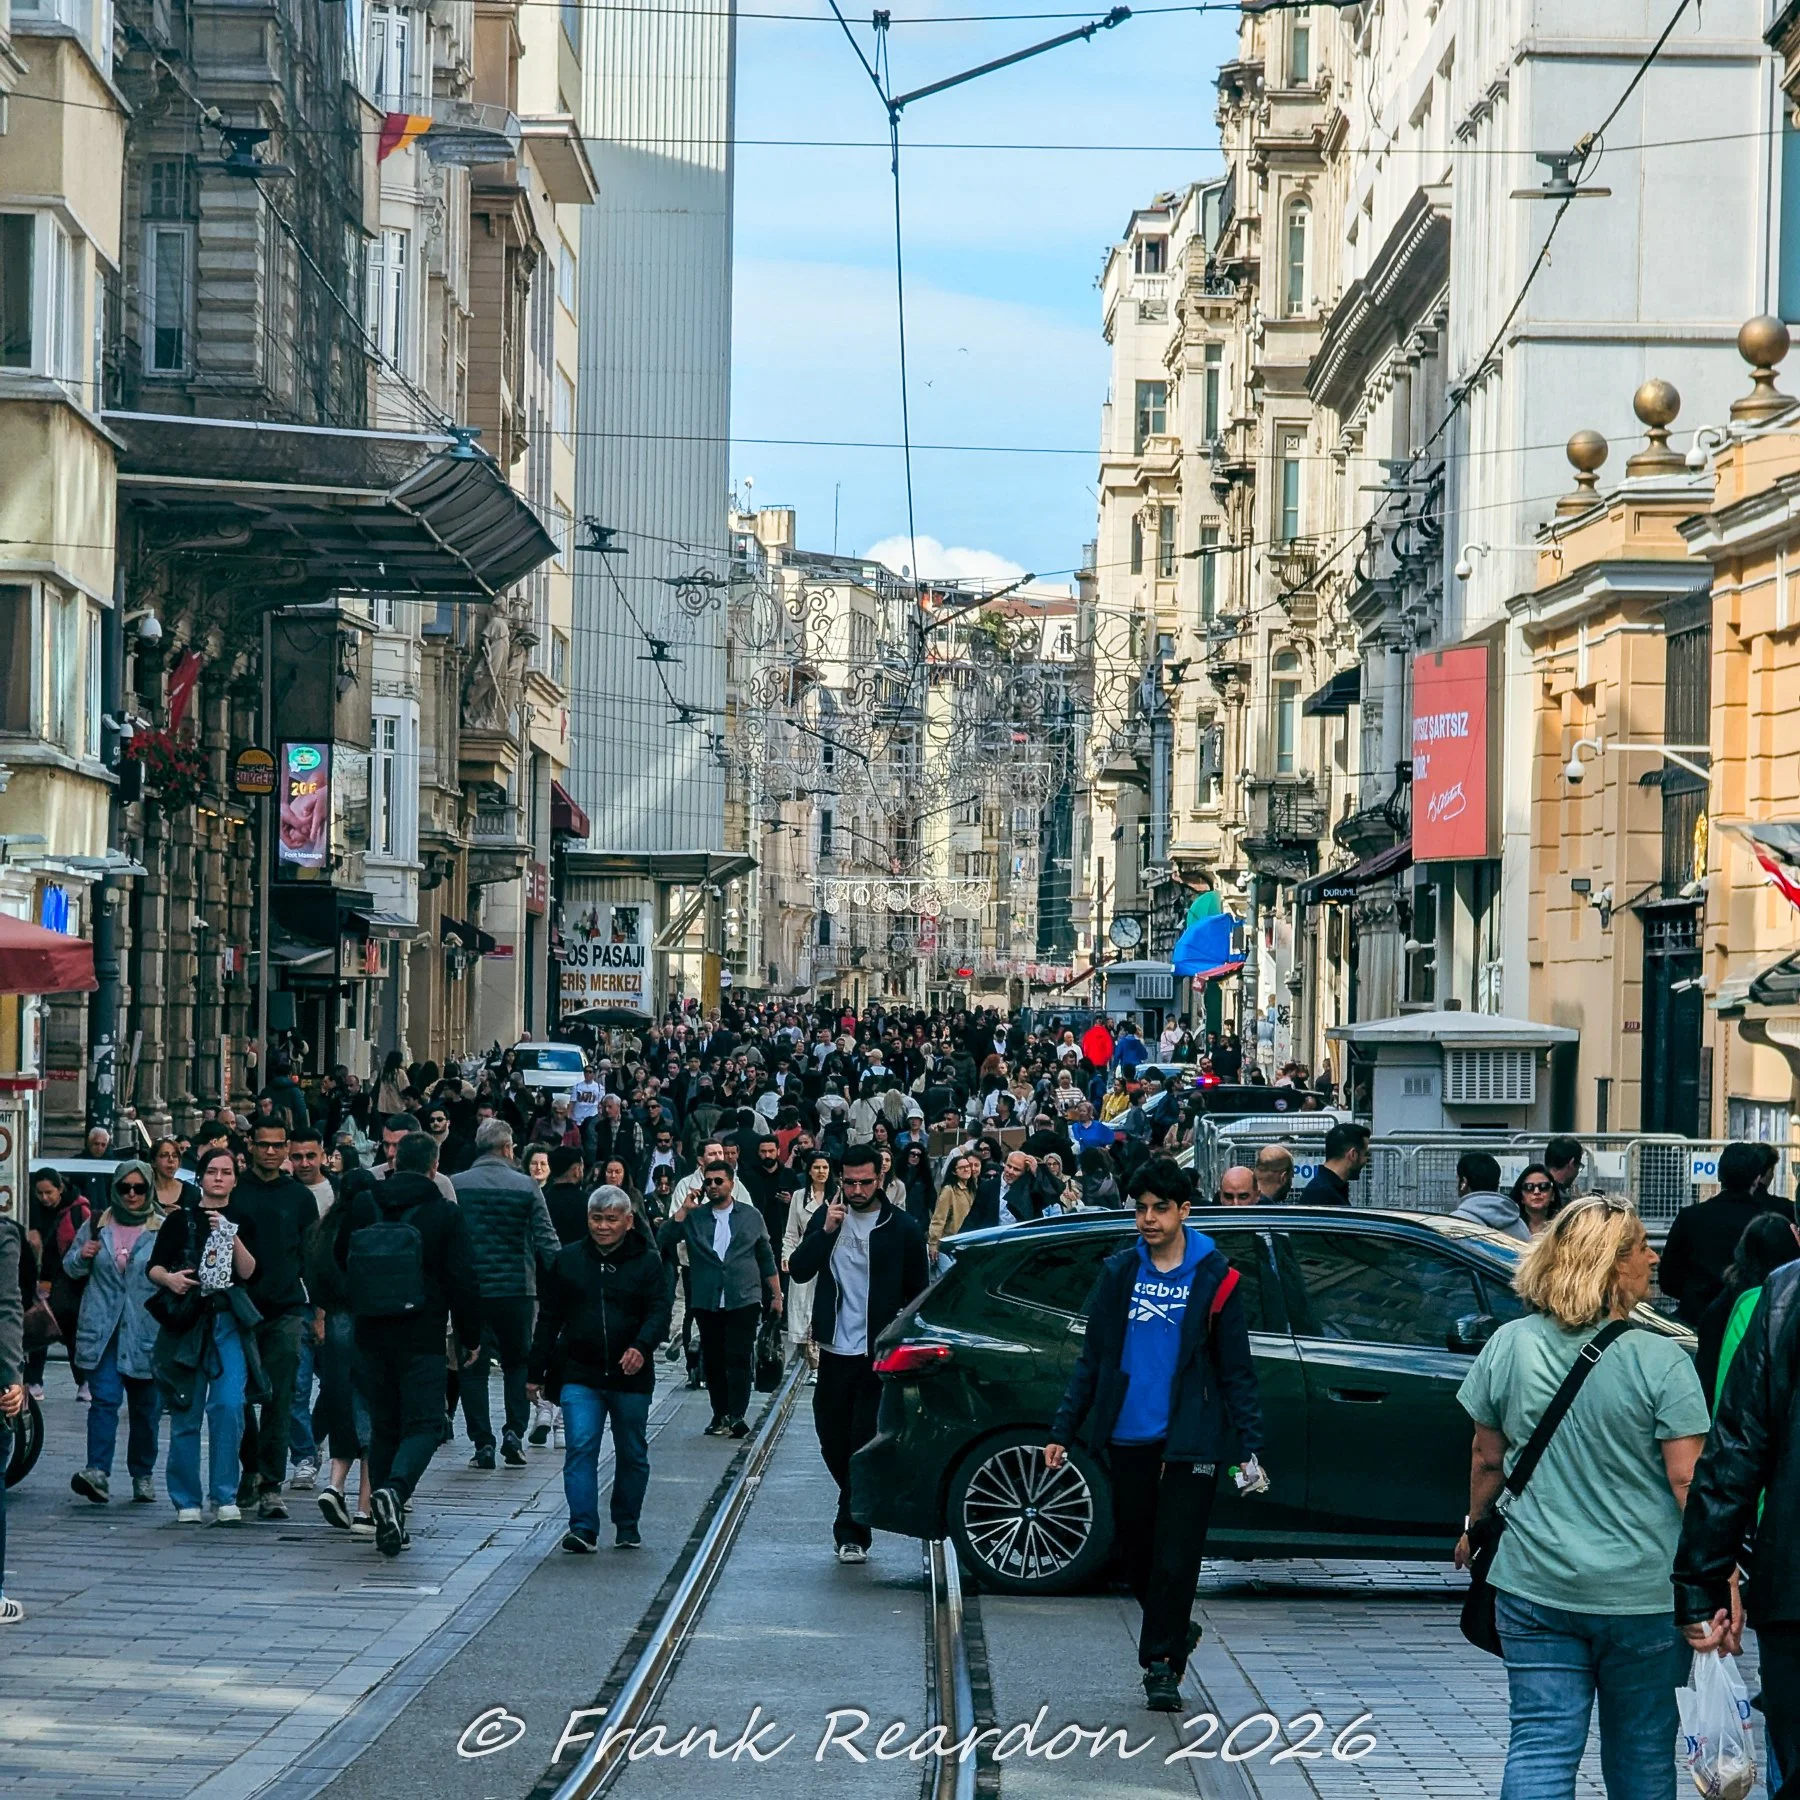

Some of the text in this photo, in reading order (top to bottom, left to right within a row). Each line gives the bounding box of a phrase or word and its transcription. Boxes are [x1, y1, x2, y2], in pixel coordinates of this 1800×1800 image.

[1429, 711, 1468, 745] ŞARTSIZ
[562, 945, 645, 968] OS PASAJI
[590, 970, 642, 992] MERKEZİ
[1693, 1161, 1716, 1176] PO
